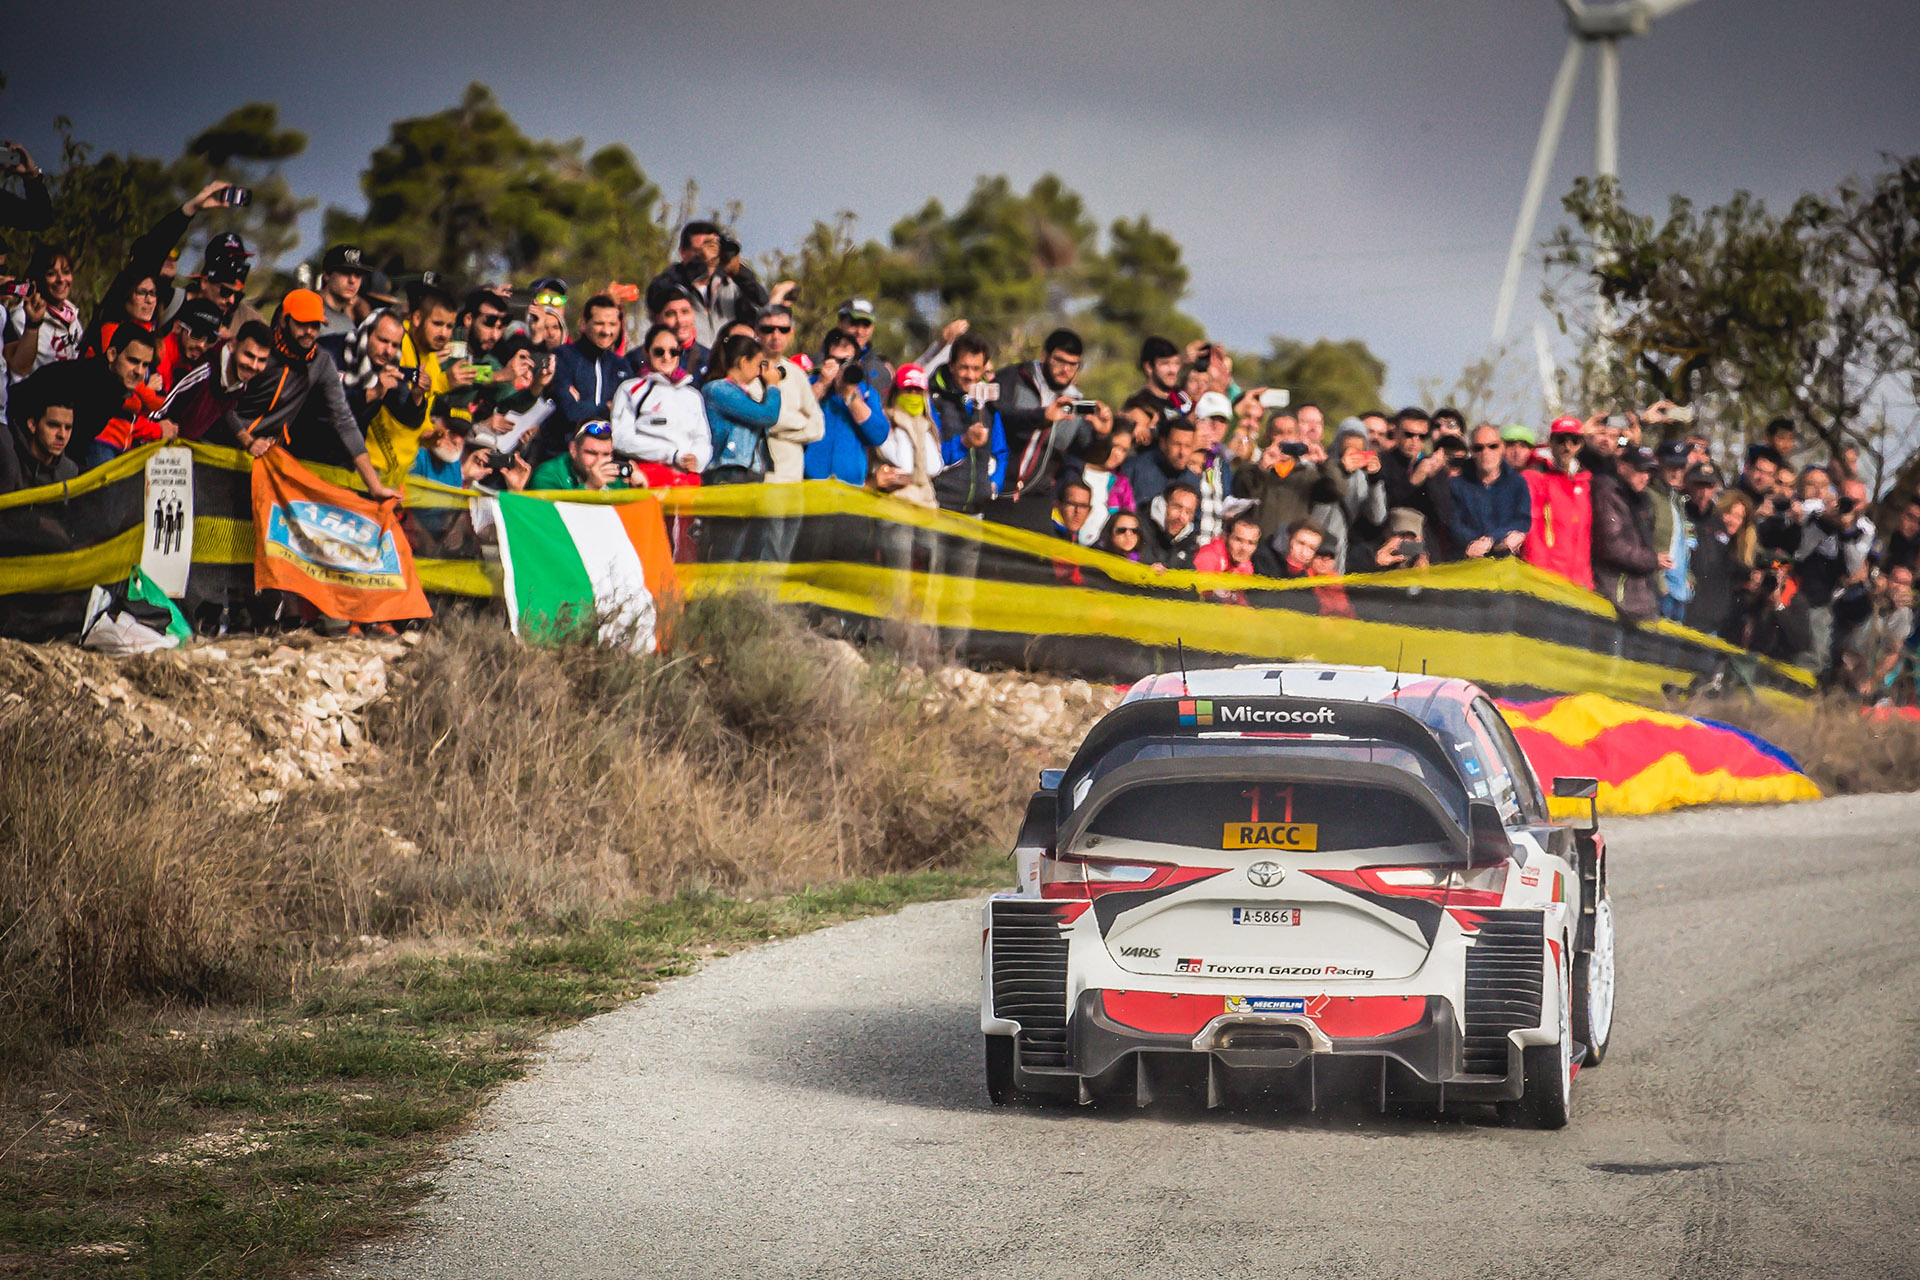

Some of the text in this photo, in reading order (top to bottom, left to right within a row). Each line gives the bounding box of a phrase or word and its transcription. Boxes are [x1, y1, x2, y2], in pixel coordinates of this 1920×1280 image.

[1220, 706, 1335, 724] Microsoft
[1242, 785, 1293, 823] 11
[1240, 826, 1300, 845] RACC
[1119, 946, 1161, 958] VARIS
[1176, 963, 1374, 978] GR TOYOTA GAZOO Racing
[1252, 1001, 1303, 1009] MICHELIN
